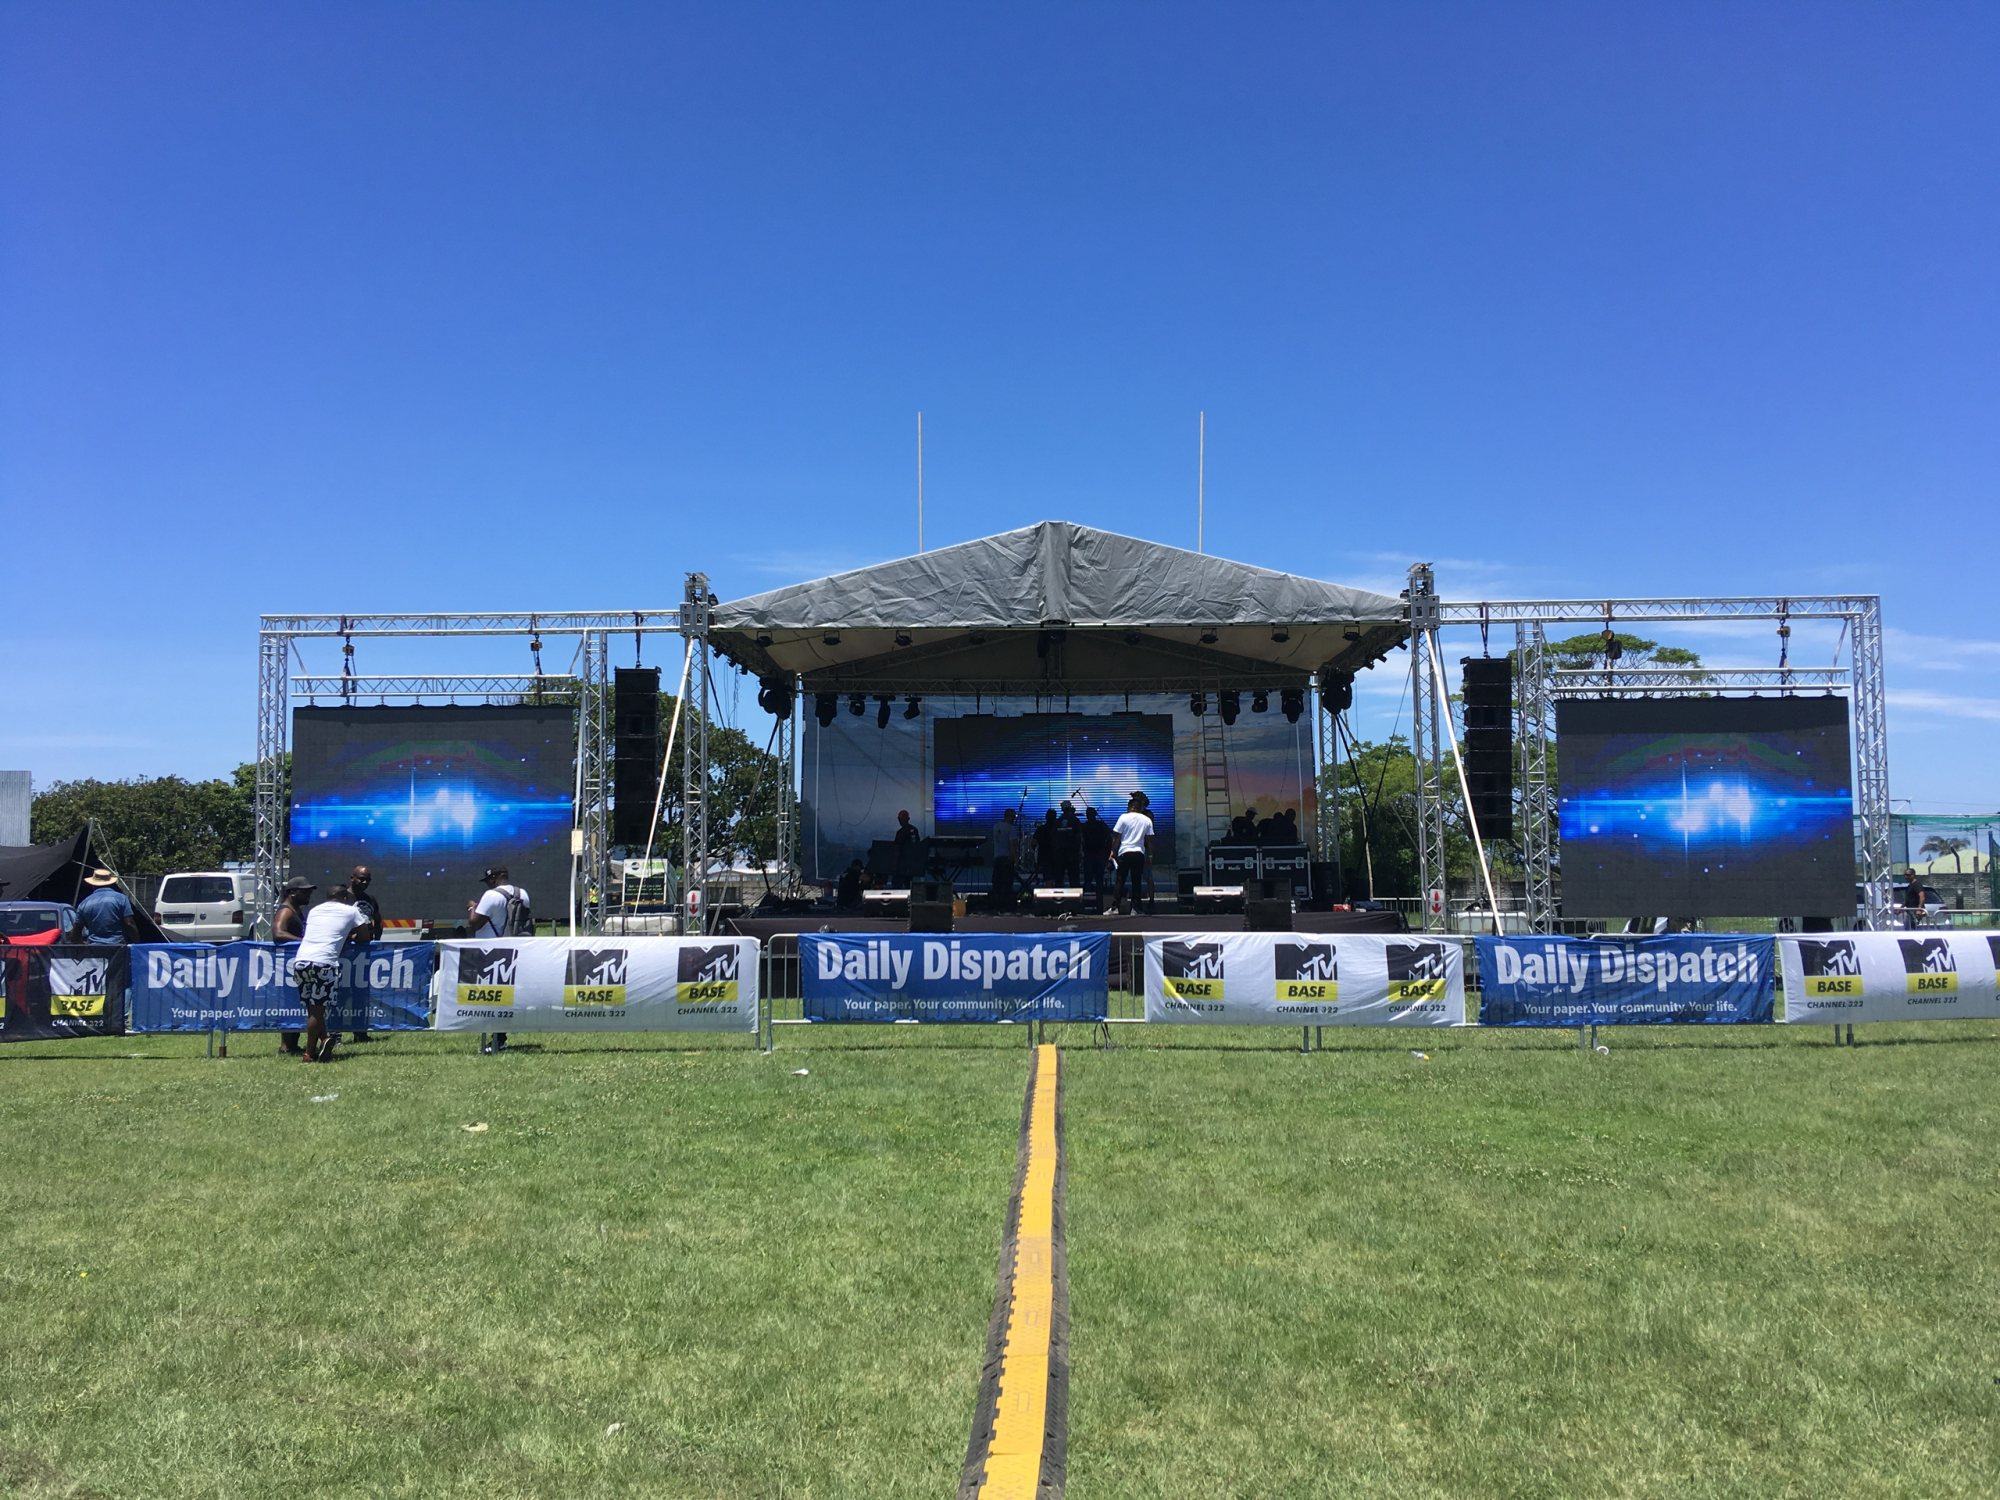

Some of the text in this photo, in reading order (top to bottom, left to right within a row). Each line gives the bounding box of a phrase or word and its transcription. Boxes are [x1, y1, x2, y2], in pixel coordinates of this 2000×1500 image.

[1162, 941, 1224, 980] MTV
[1275, 944, 1338, 980] MTV
[1385, 944, 1446, 980] MTV
[1798, 940, 1862, 976] MTV
[1897, 938, 1957, 974] MTV
[458, 947, 518, 985] MTV
[563, 949, 628, 985] MTV
[676, 944, 741, 982] MTV
[817, 940, 1091, 990] Daily Dispatch
[1495, 944, 1758, 993] Daily Dispatch
[50, 958, 109, 996] MTV
[148, 948, 414, 998] Daily Disatch
[1175, 984, 1212, 996] BASE
[1817, 981, 1852, 992] BASE
[1917, 978, 1948, 990] BASE
[467, 990, 502, 1003] BASE
[575, 990, 613, 1002] BASE
[688, 986, 725, 999] BASE
[1288, 985, 1326, 998] BASE
[1400, 985, 1435, 997] BASE
[61, 1000, 95, 1012] BASE
[677, 1006, 738, 1016] CHANNEL 322
[844, 999, 1065, 1012] Your paper. Your community. Your life.
[1164, 1002, 1225, 1012] CHANNEL 322
[1276, 1006, 1339, 1014] CHANNEL 322
[1388, 1004, 1447, 1013] CHANNEL 322
[1524, 1000, 1738, 1015] Your paper. Your community. Your life.
[171, 1006, 387, 1020] Your paper. Your commuy. Your life.
[456, 1009, 514, 1018] CHANNEL 322
[565, 1010, 626, 1018] CHANNEL 322
